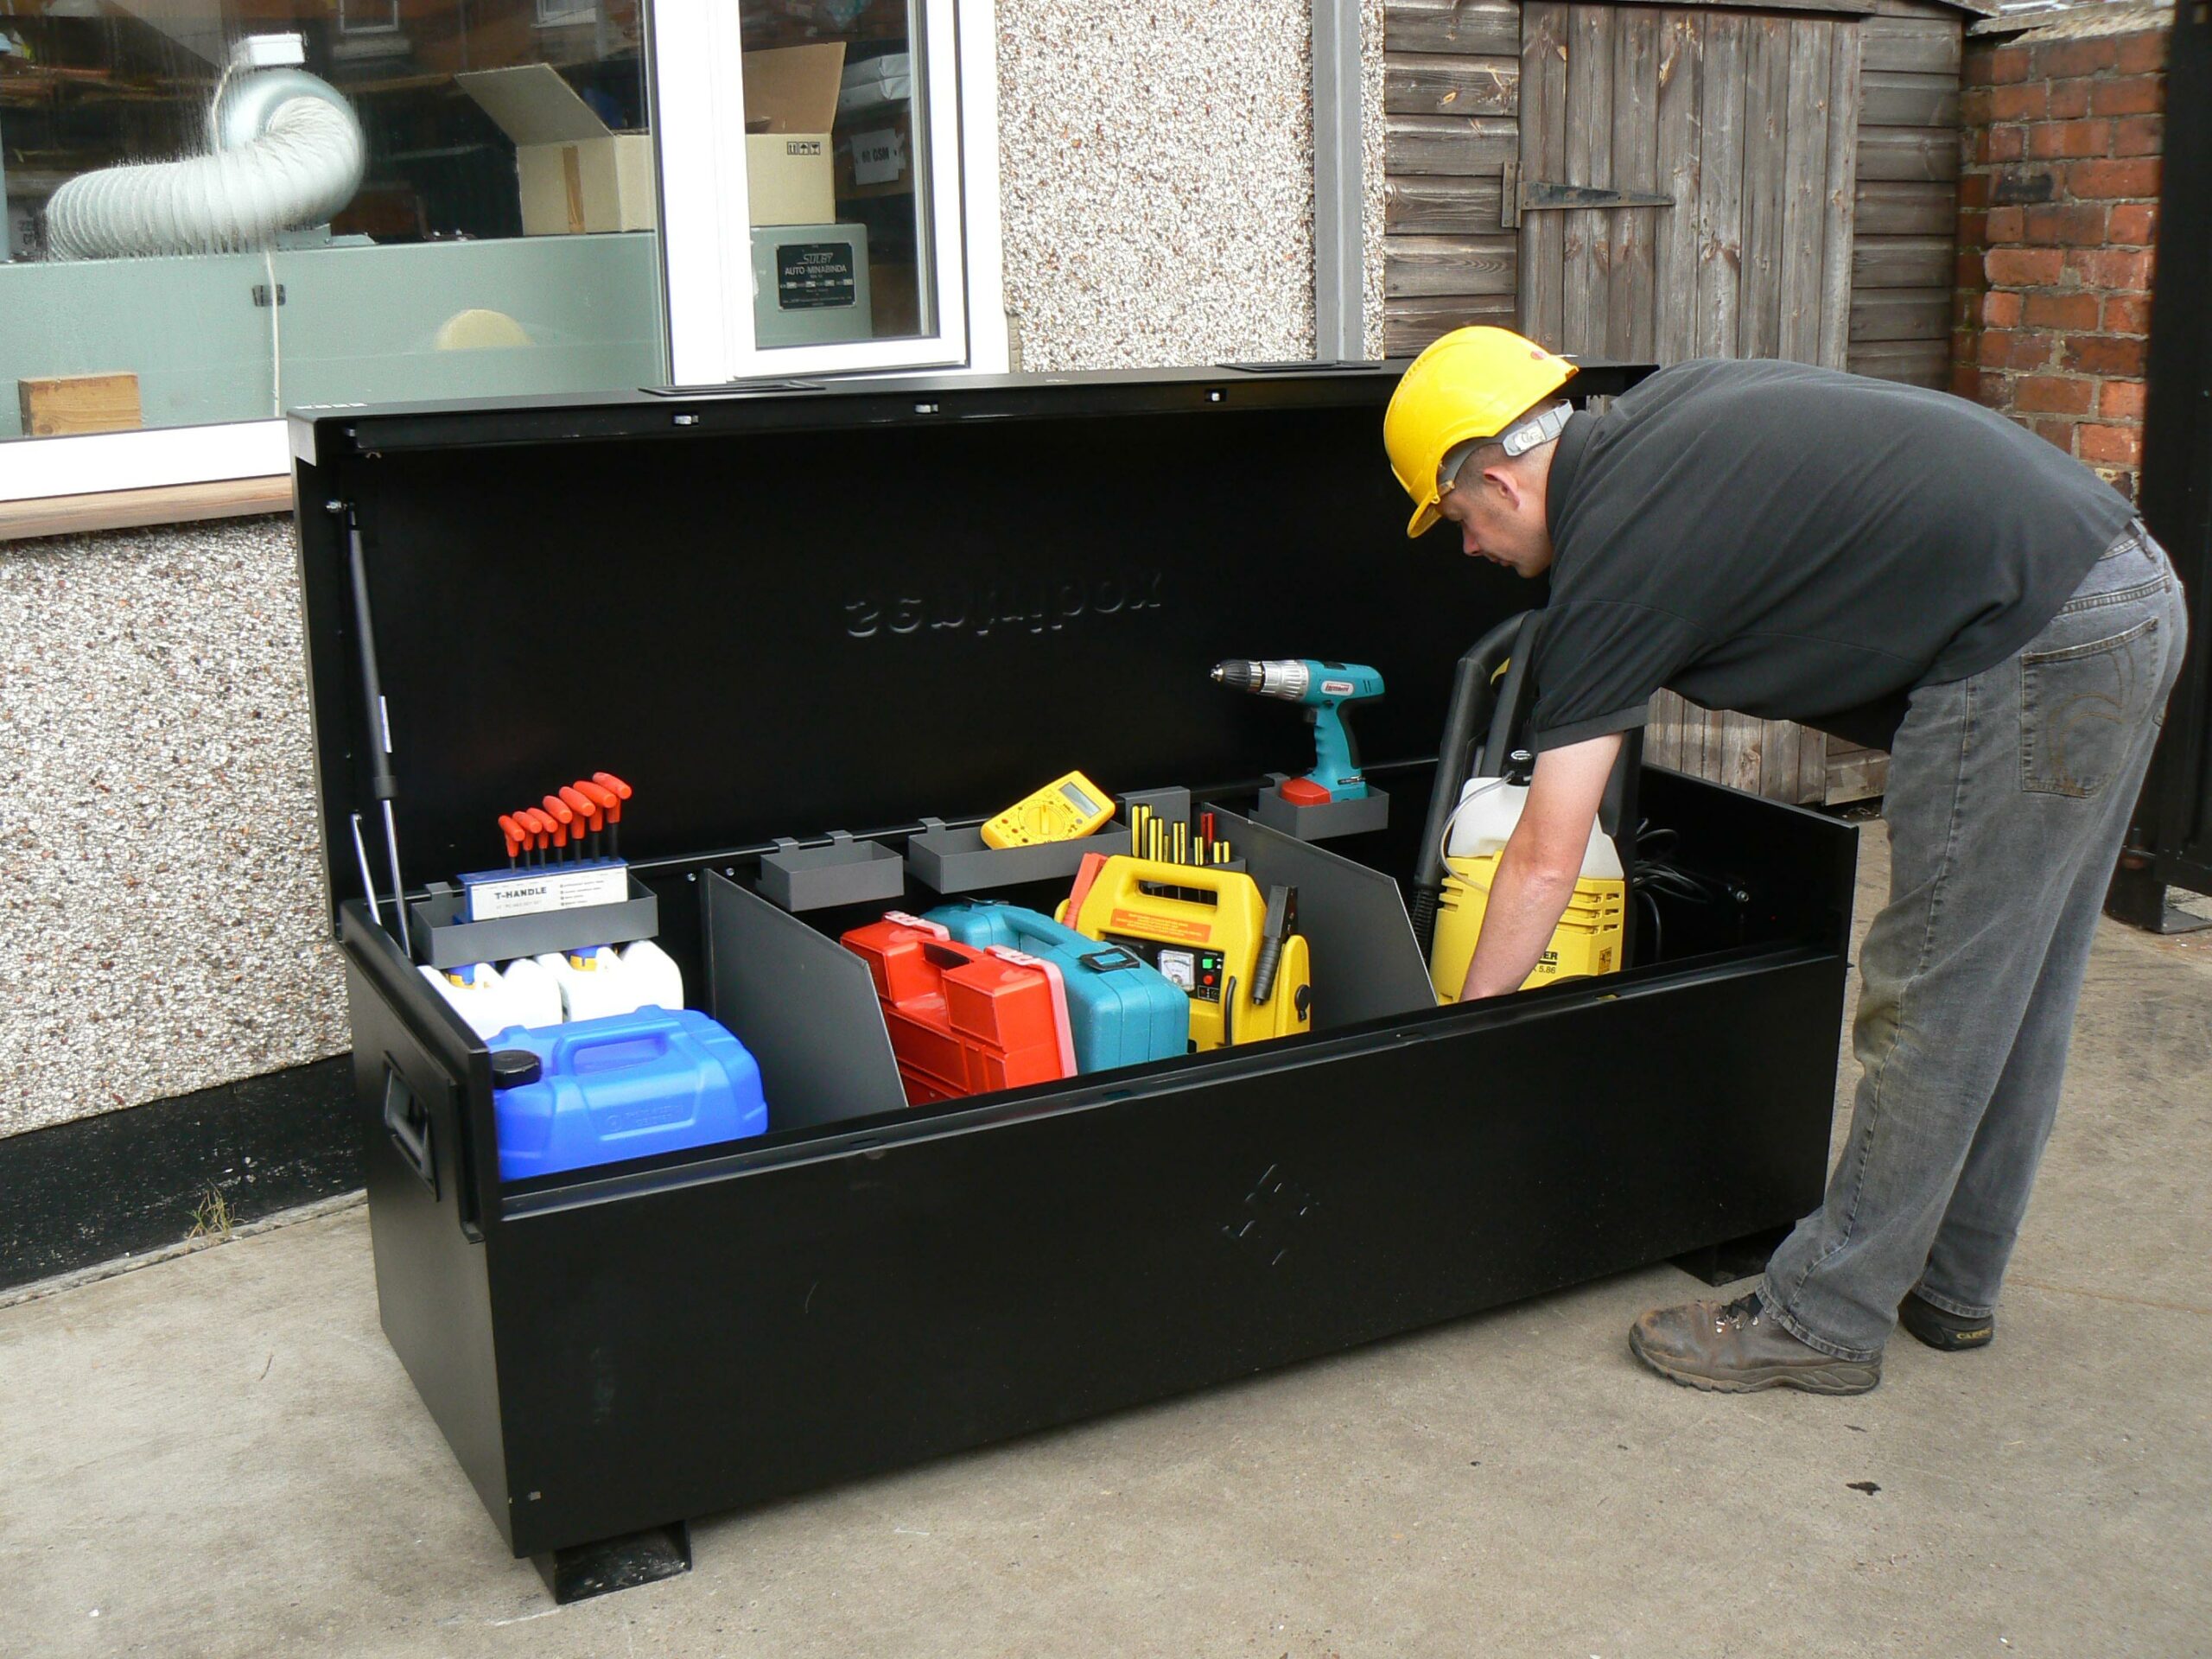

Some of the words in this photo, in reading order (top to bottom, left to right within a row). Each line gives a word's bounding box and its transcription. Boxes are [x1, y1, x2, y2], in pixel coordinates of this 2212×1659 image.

[785, 266, 805, 276] AUTO
[806, 264, 847, 274] MINABINDA
[494, 887, 547, 899] T-HANDLE
[1538, 965, 1556, 974] 5.86
